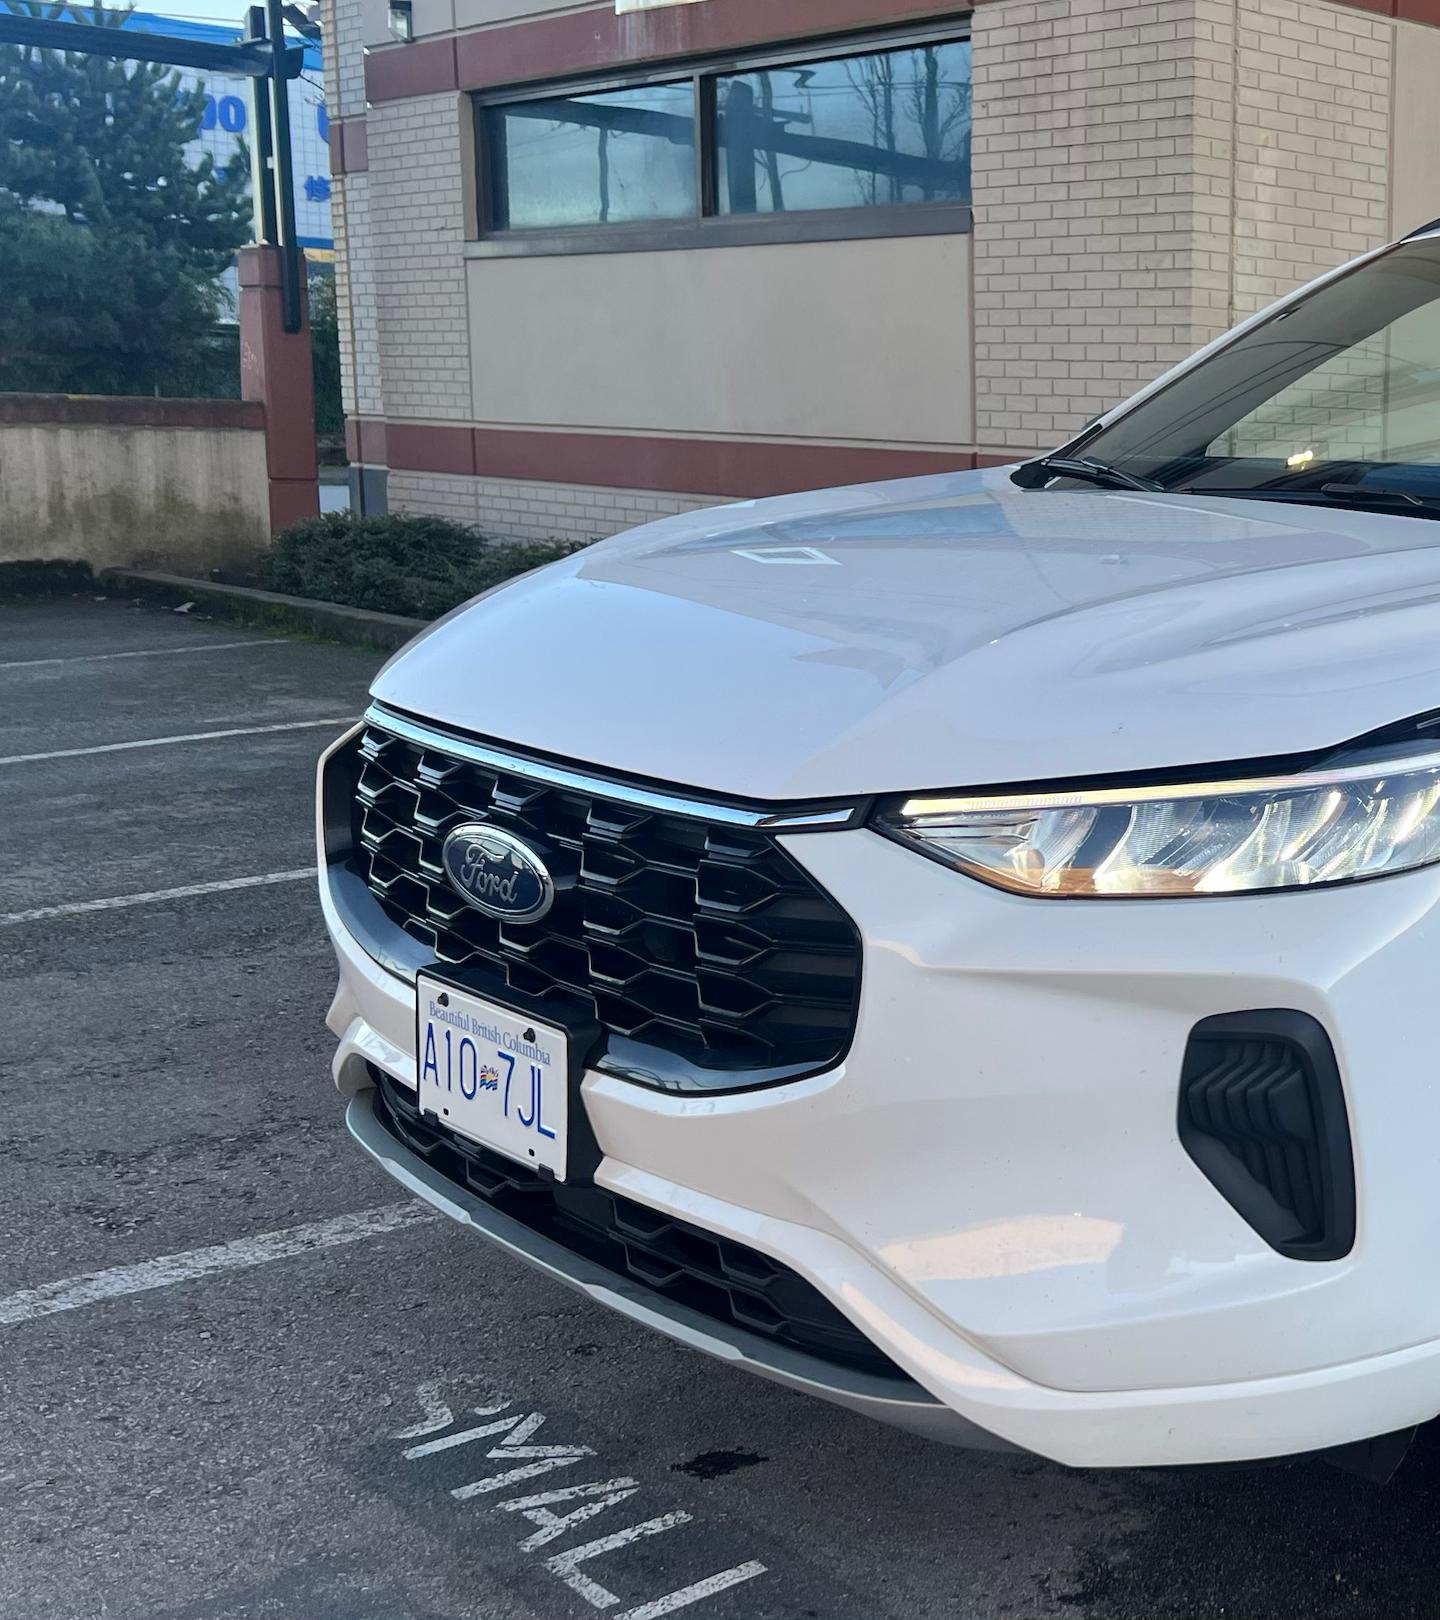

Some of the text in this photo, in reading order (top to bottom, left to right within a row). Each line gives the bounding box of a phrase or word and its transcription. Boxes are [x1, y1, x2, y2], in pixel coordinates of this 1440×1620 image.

[461, 843, 518, 904] Ford
[429, 1000, 552, 1066] Beautiful British Columbia
[423, 1019, 557, 1140] A10 7JL
